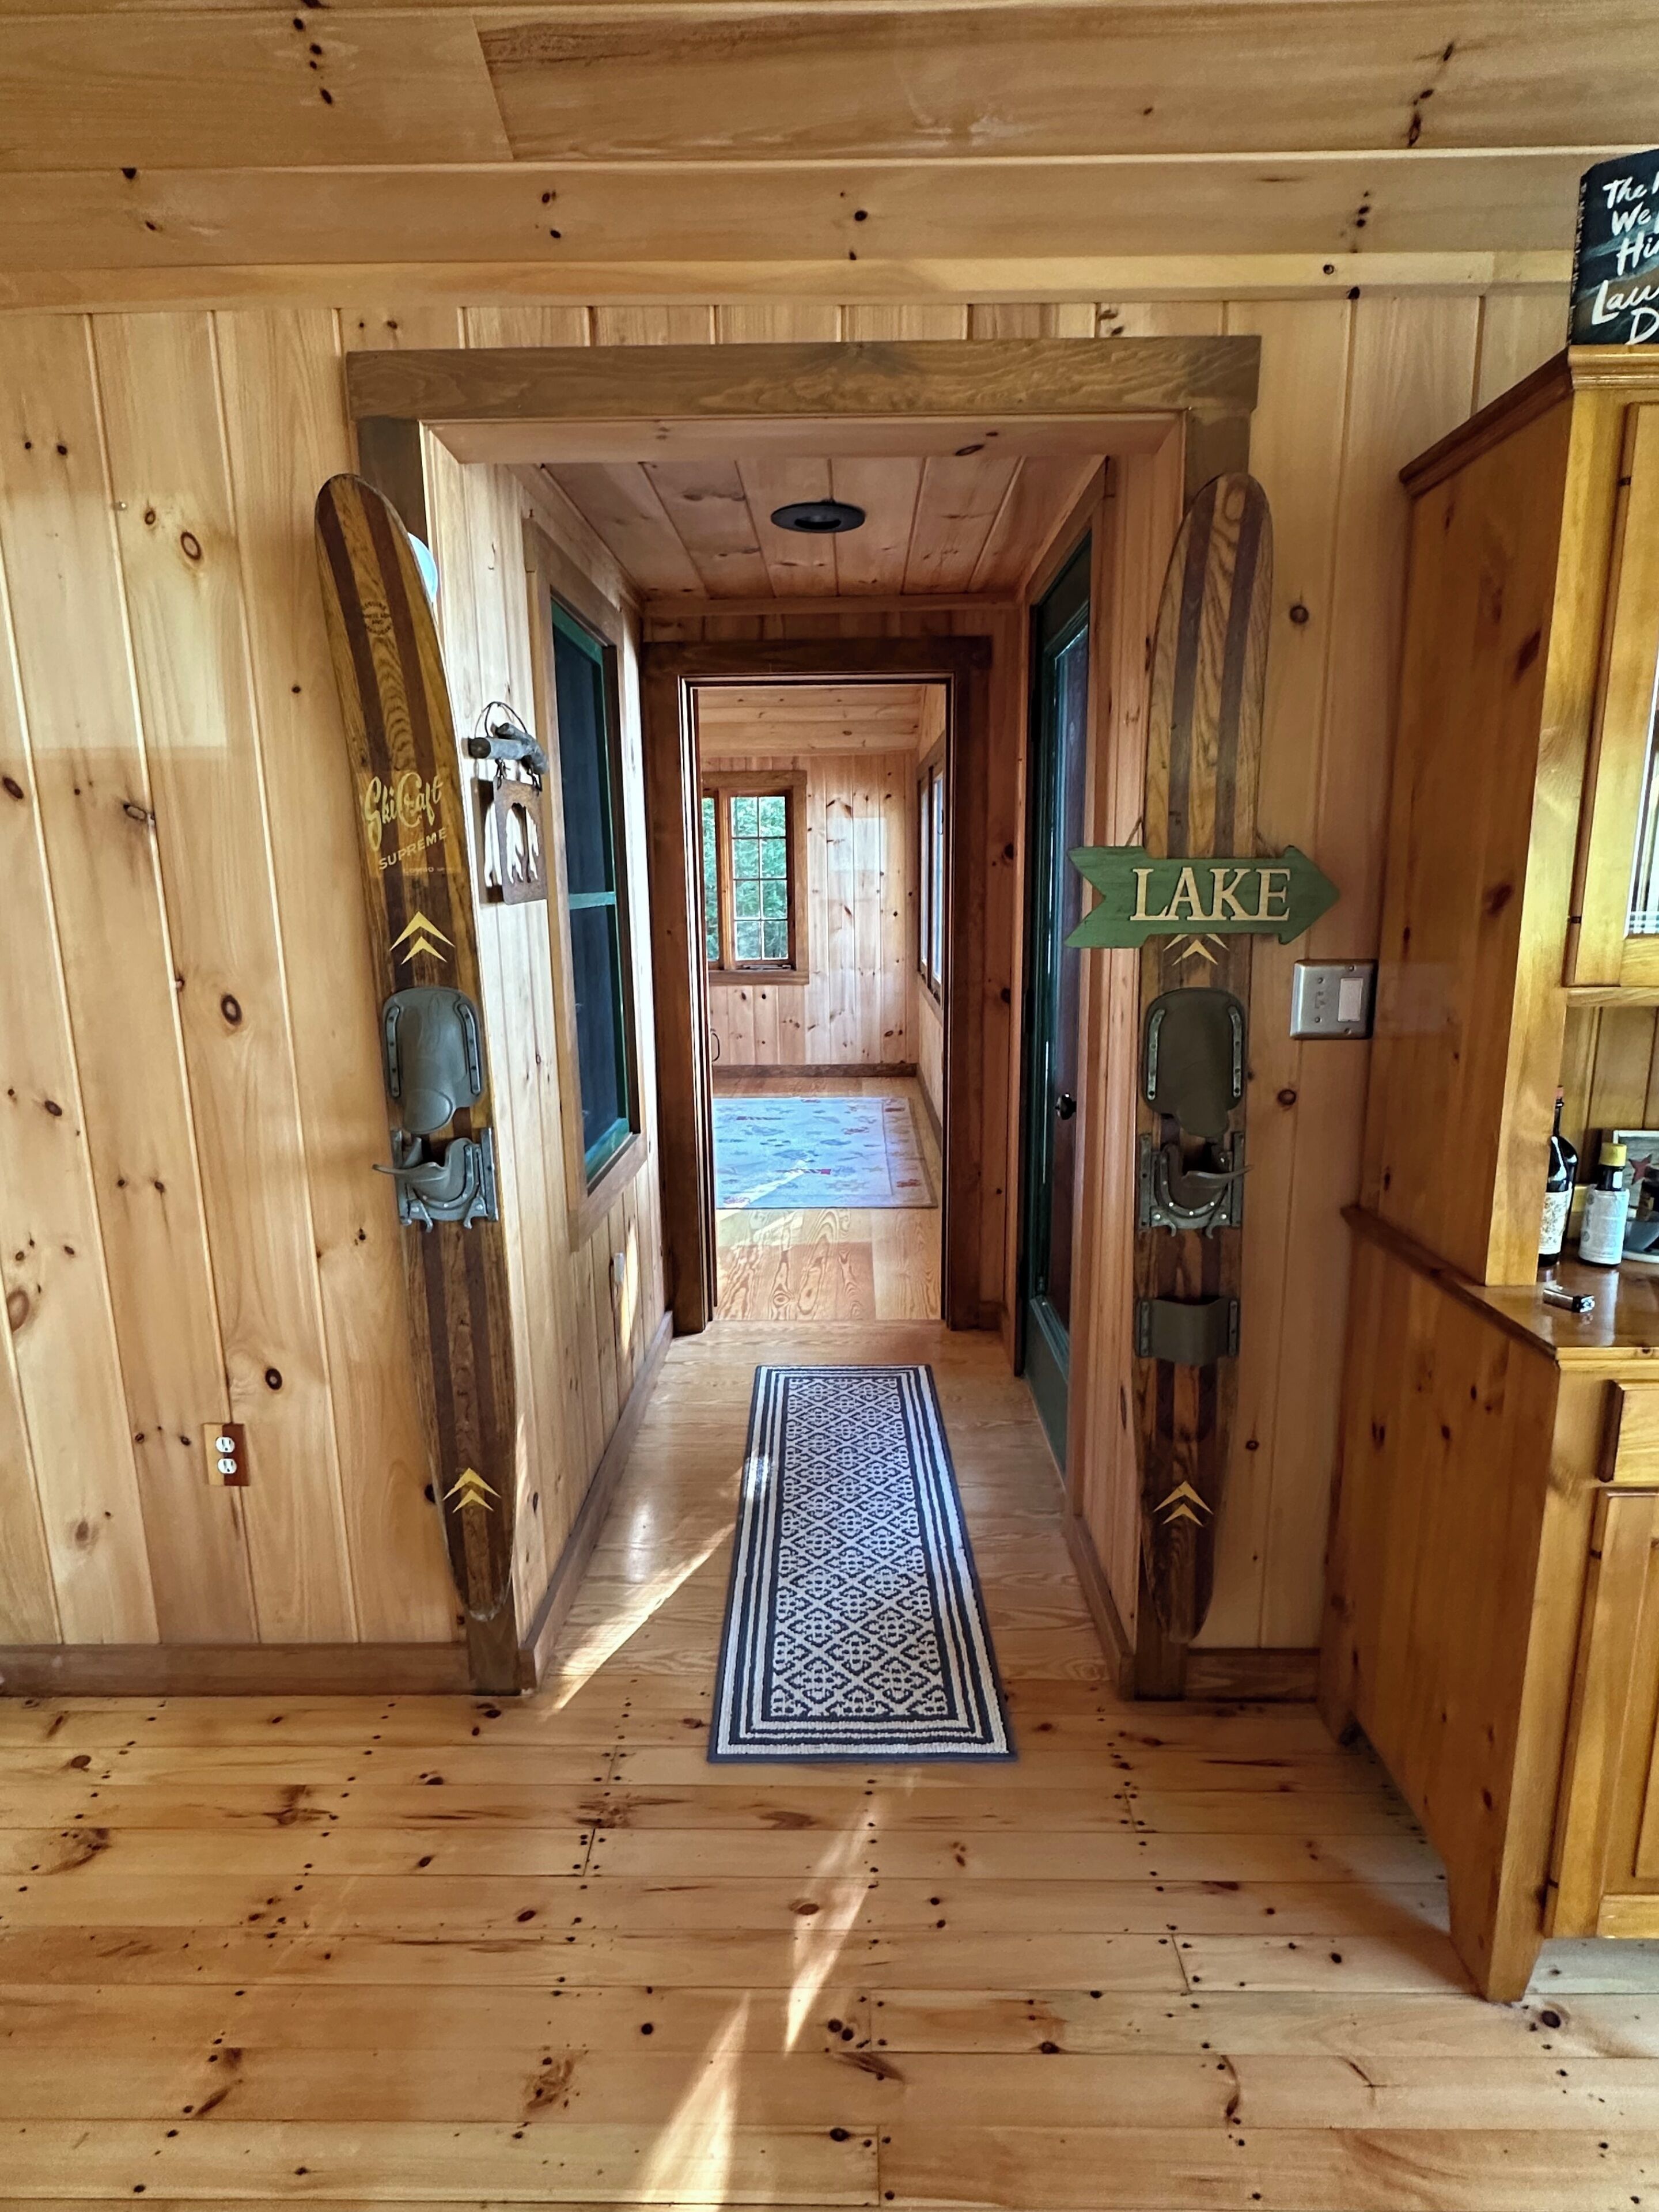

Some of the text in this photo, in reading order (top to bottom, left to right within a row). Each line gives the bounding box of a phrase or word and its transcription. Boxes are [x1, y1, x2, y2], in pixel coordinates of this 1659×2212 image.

[1603, 176, 1647, 209] The
[1611, 202, 1652, 236] We
[1592, 280, 1659, 324] Lau
[378, 827, 448, 870] SUPREME
[1129, 867, 1291, 921] LAKE
